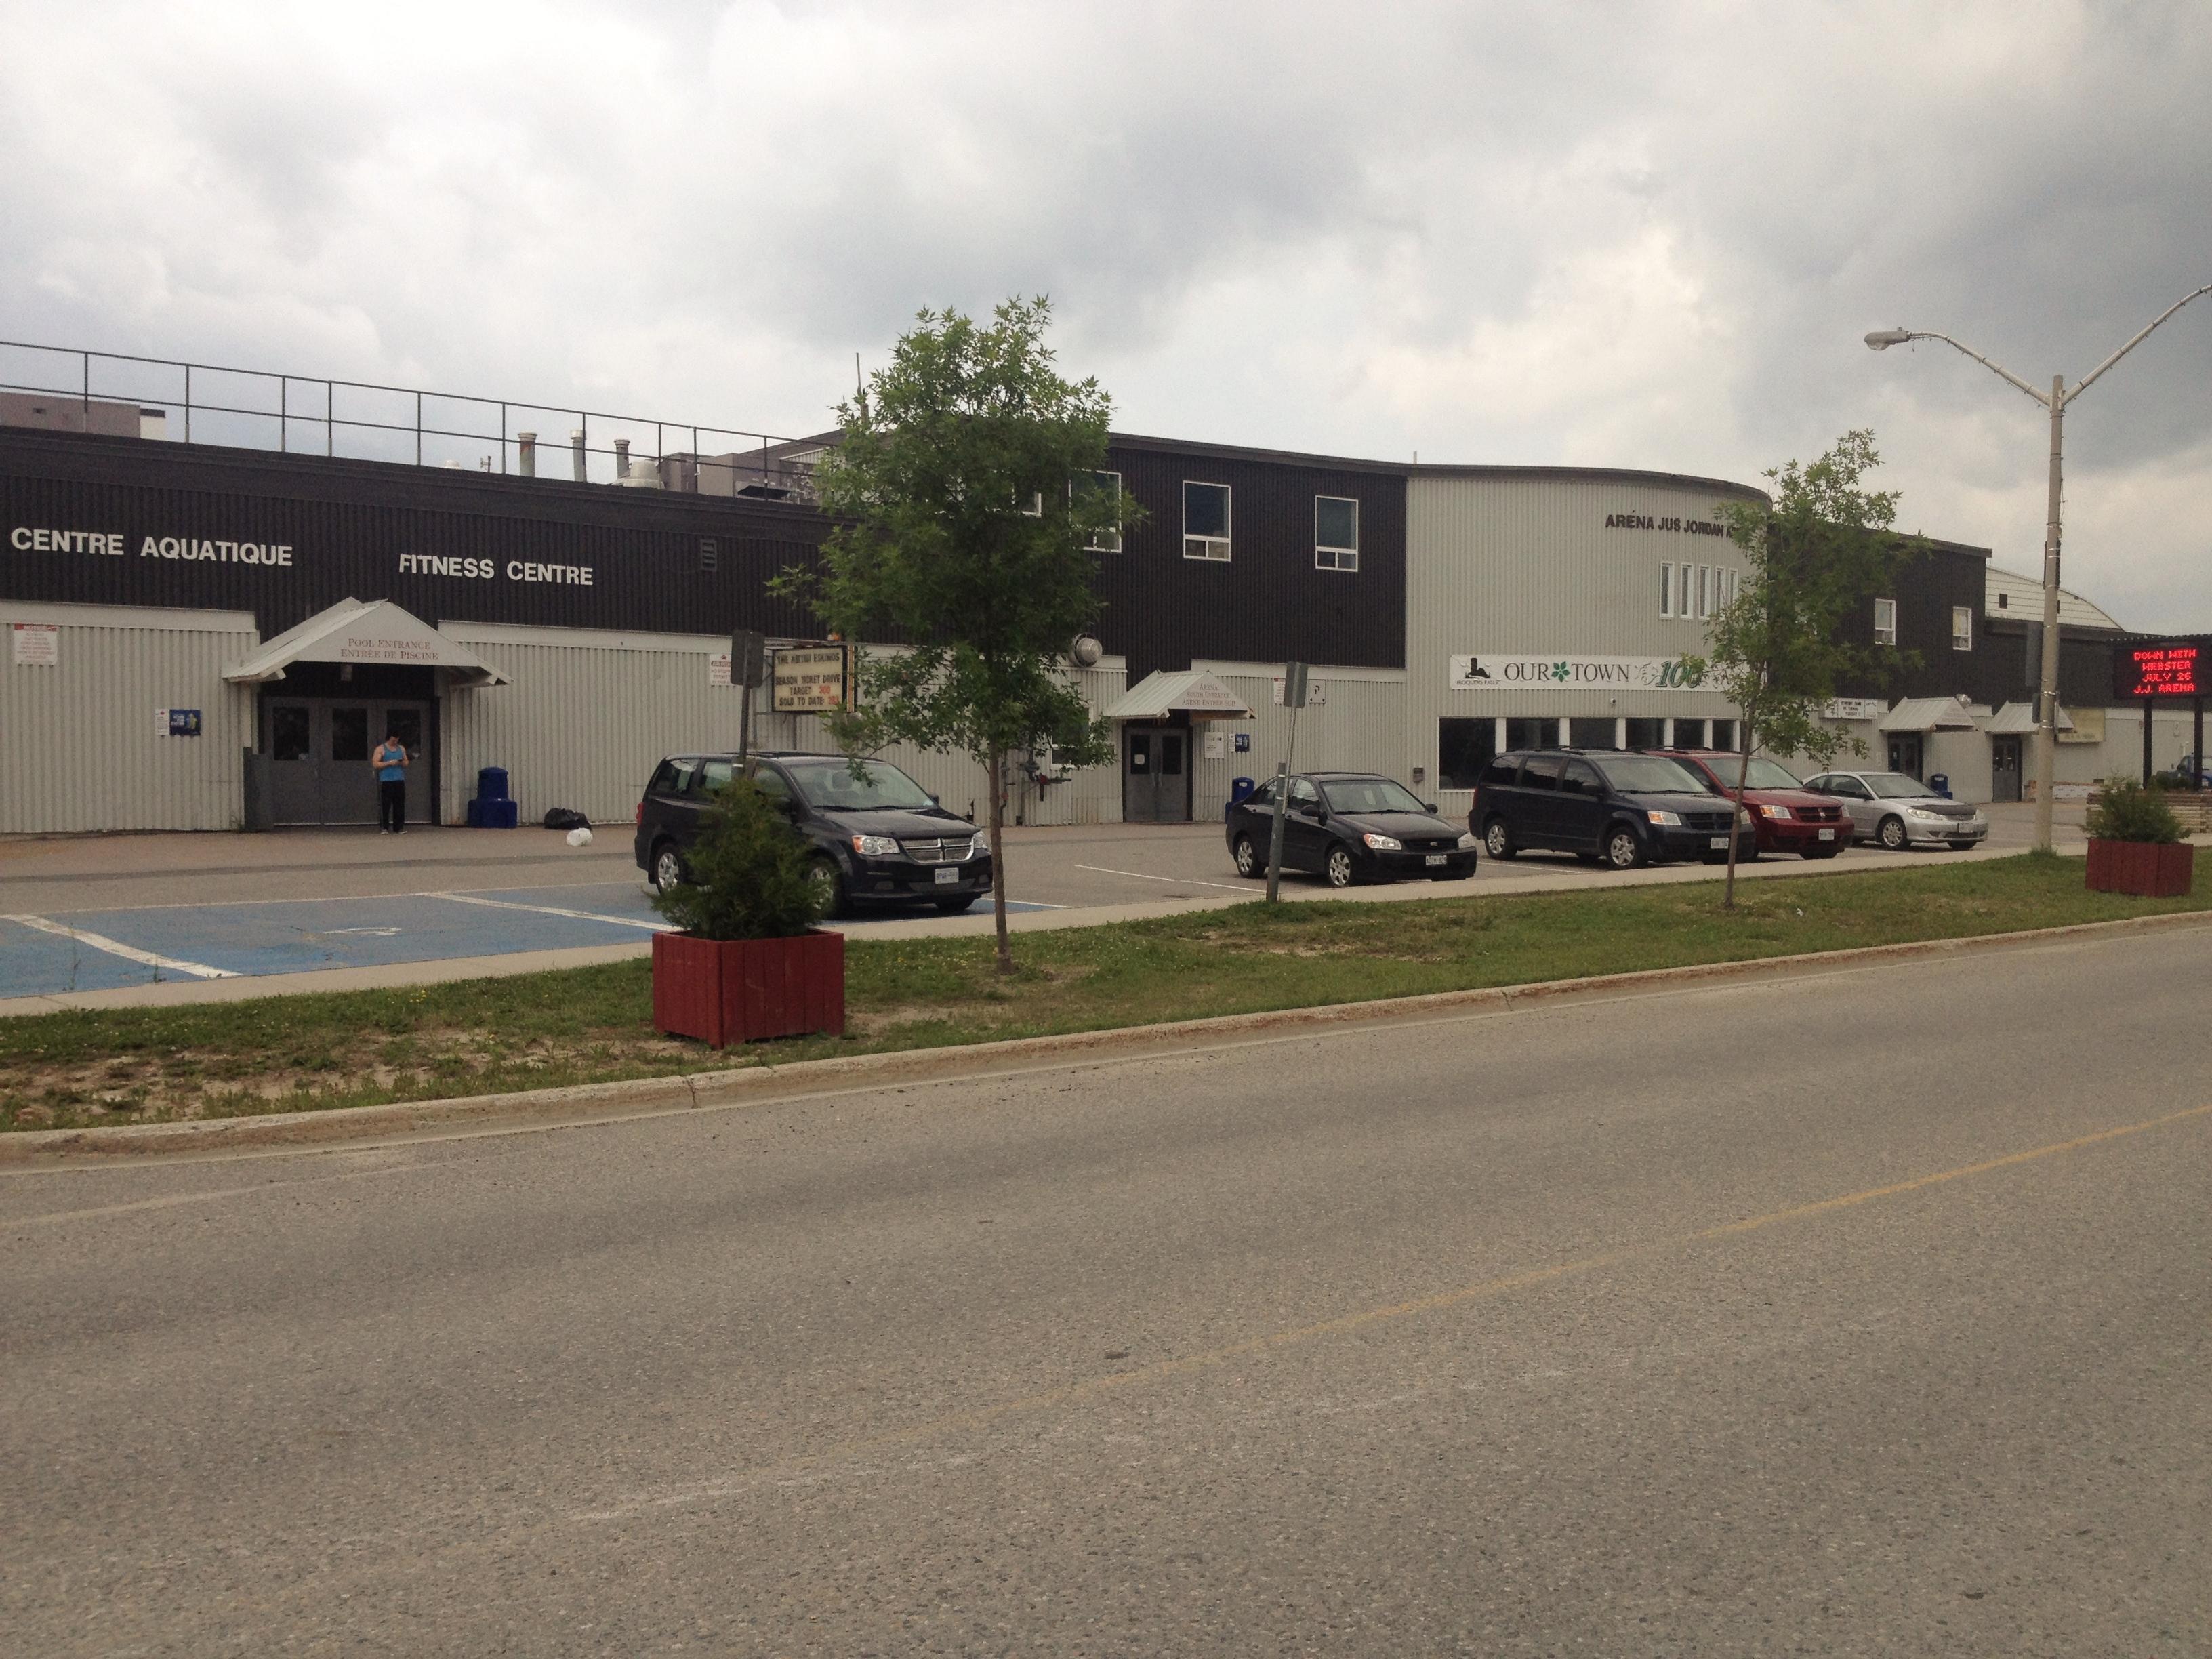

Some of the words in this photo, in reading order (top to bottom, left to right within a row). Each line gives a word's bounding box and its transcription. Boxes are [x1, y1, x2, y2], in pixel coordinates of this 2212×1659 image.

[1605, 510, 1654, 530] ARÉNA
[1658, 517, 1681, 532] JUS
[1684, 520, 1724, 537] JORDAN
[11, 527, 124, 555] CENTRE
[140, 537, 293, 566] AQUATIQUE
[399, 554, 495, 579] FITNESS
[507, 560, 593, 586] CENTRE
[348, 638, 374, 647] POOL
[378, 640, 430, 649] ENTRANCE
[401, 651, 438, 660] PISCINE
[2133, 651, 2163, 661] DOWN
[2169, 649, 2196, 658] WITH
[2142, 661, 2192, 671] WEBSTER
[1504, 663, 1551, 681] OUR
[1571, 663, 1629, 682] TOWN
[2142, 673, 2171, 682] JULY
[2177, 672, 2191, 681] 26
[2133, 684, 2154, 693] J.J.
[2158, 683, 2194, 693] ARENA
[779, 697, 794, 706] SOLD
[798, 697, 805, 705] TO
